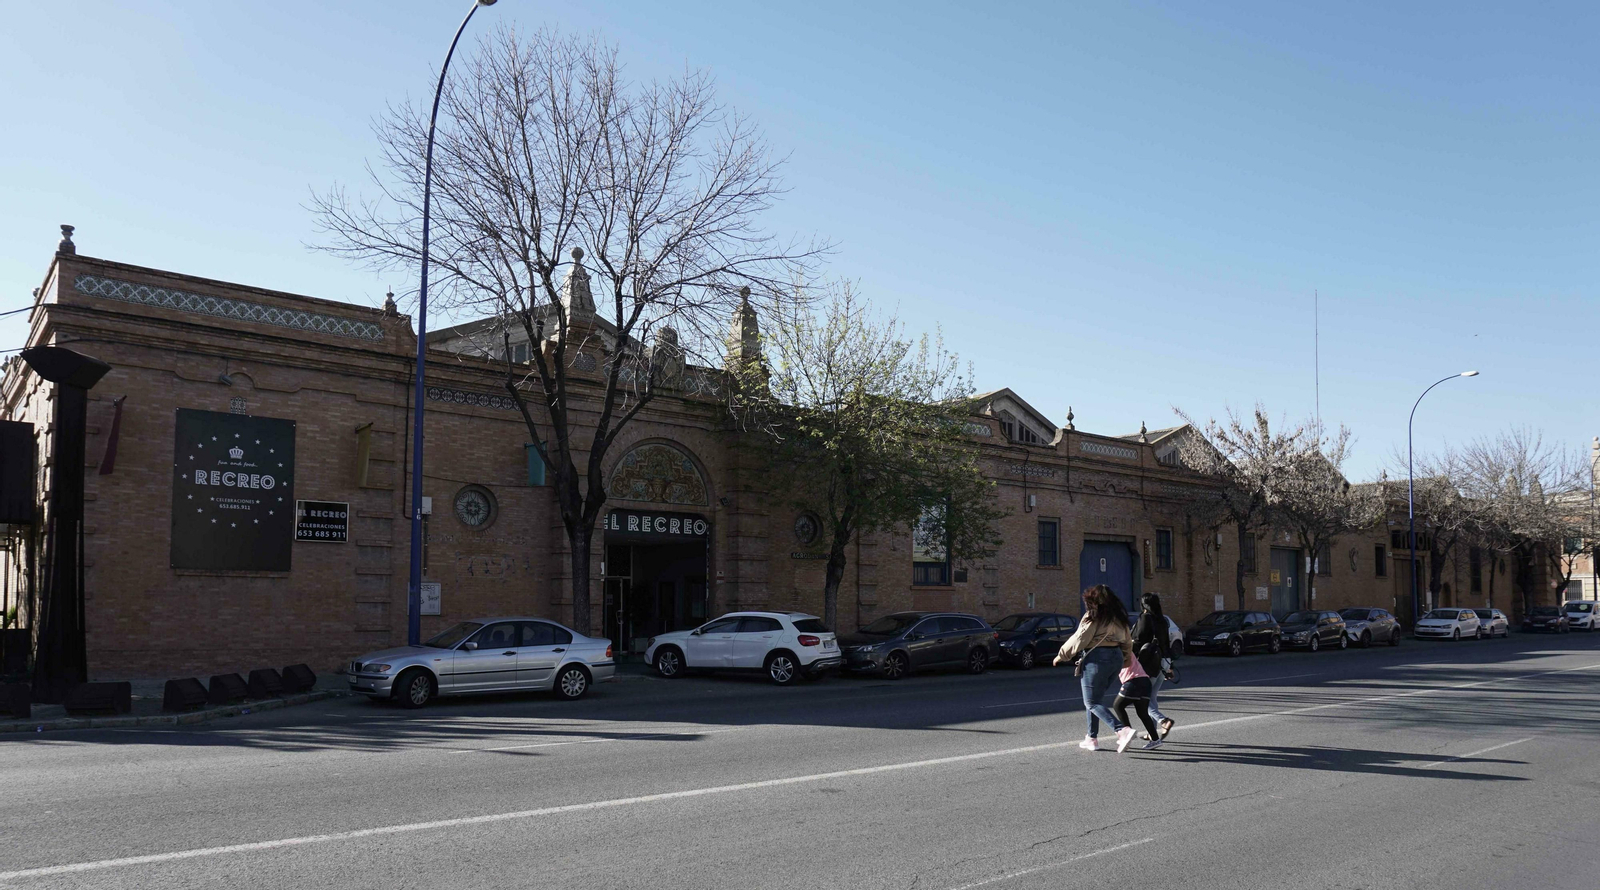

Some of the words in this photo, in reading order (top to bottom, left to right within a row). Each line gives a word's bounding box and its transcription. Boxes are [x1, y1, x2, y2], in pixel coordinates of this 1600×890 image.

[195, 469, 275, 490] RECREO
[298, 509, 307, 517] EL
[310, 510, 347, 519] RECREO
[628, 515, 706, 535] RECREO
